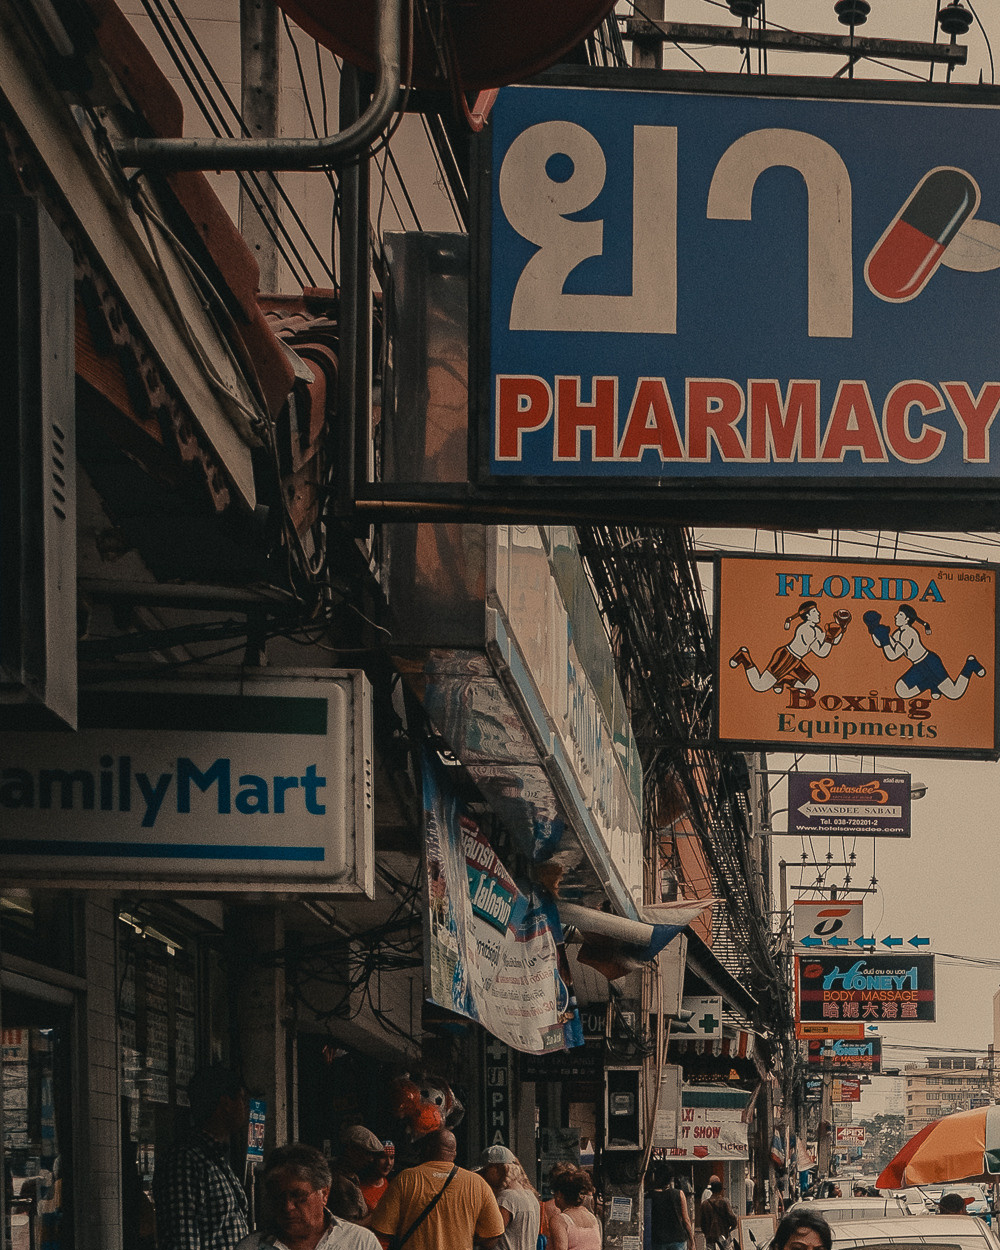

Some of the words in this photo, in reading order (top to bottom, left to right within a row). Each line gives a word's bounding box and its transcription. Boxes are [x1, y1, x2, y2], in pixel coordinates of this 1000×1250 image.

[499, 120, 853, 338] ยา
[776, 572, 945, 602] FLORIDA
[786, 687, 932, 720] Boxing
[777, 712, 938, 739] Equipments
[809, 778, 889, 804] Sawasdee
[824, 990, 856, 1001] BODY
[861, 990, 918, 1001] MASSAGE
[694, 1126, 721, 1138] SHOW
[718, 1143, 748, 1151] Ticket
